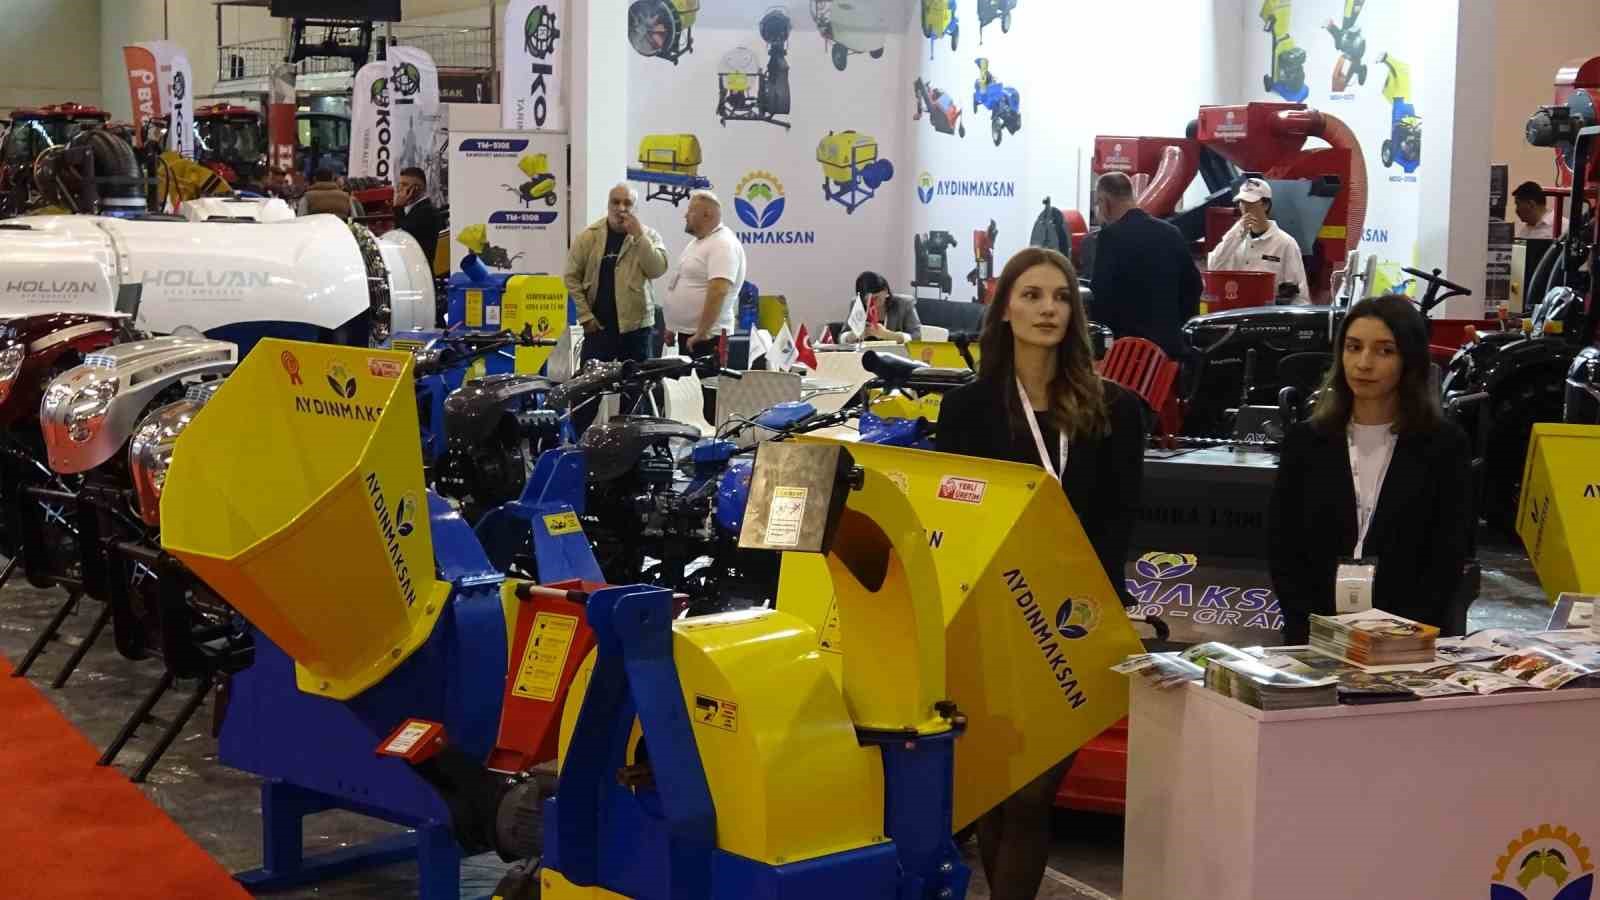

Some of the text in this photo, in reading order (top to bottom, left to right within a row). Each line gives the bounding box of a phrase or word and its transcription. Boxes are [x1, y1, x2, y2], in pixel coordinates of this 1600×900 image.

[937, 180, 1015, 197] AYDINMAKSAN
[366, 471, 416, 608] AYDINMAKSAN
[1003, 568, 1088, 710] AYDINMAKSAN
